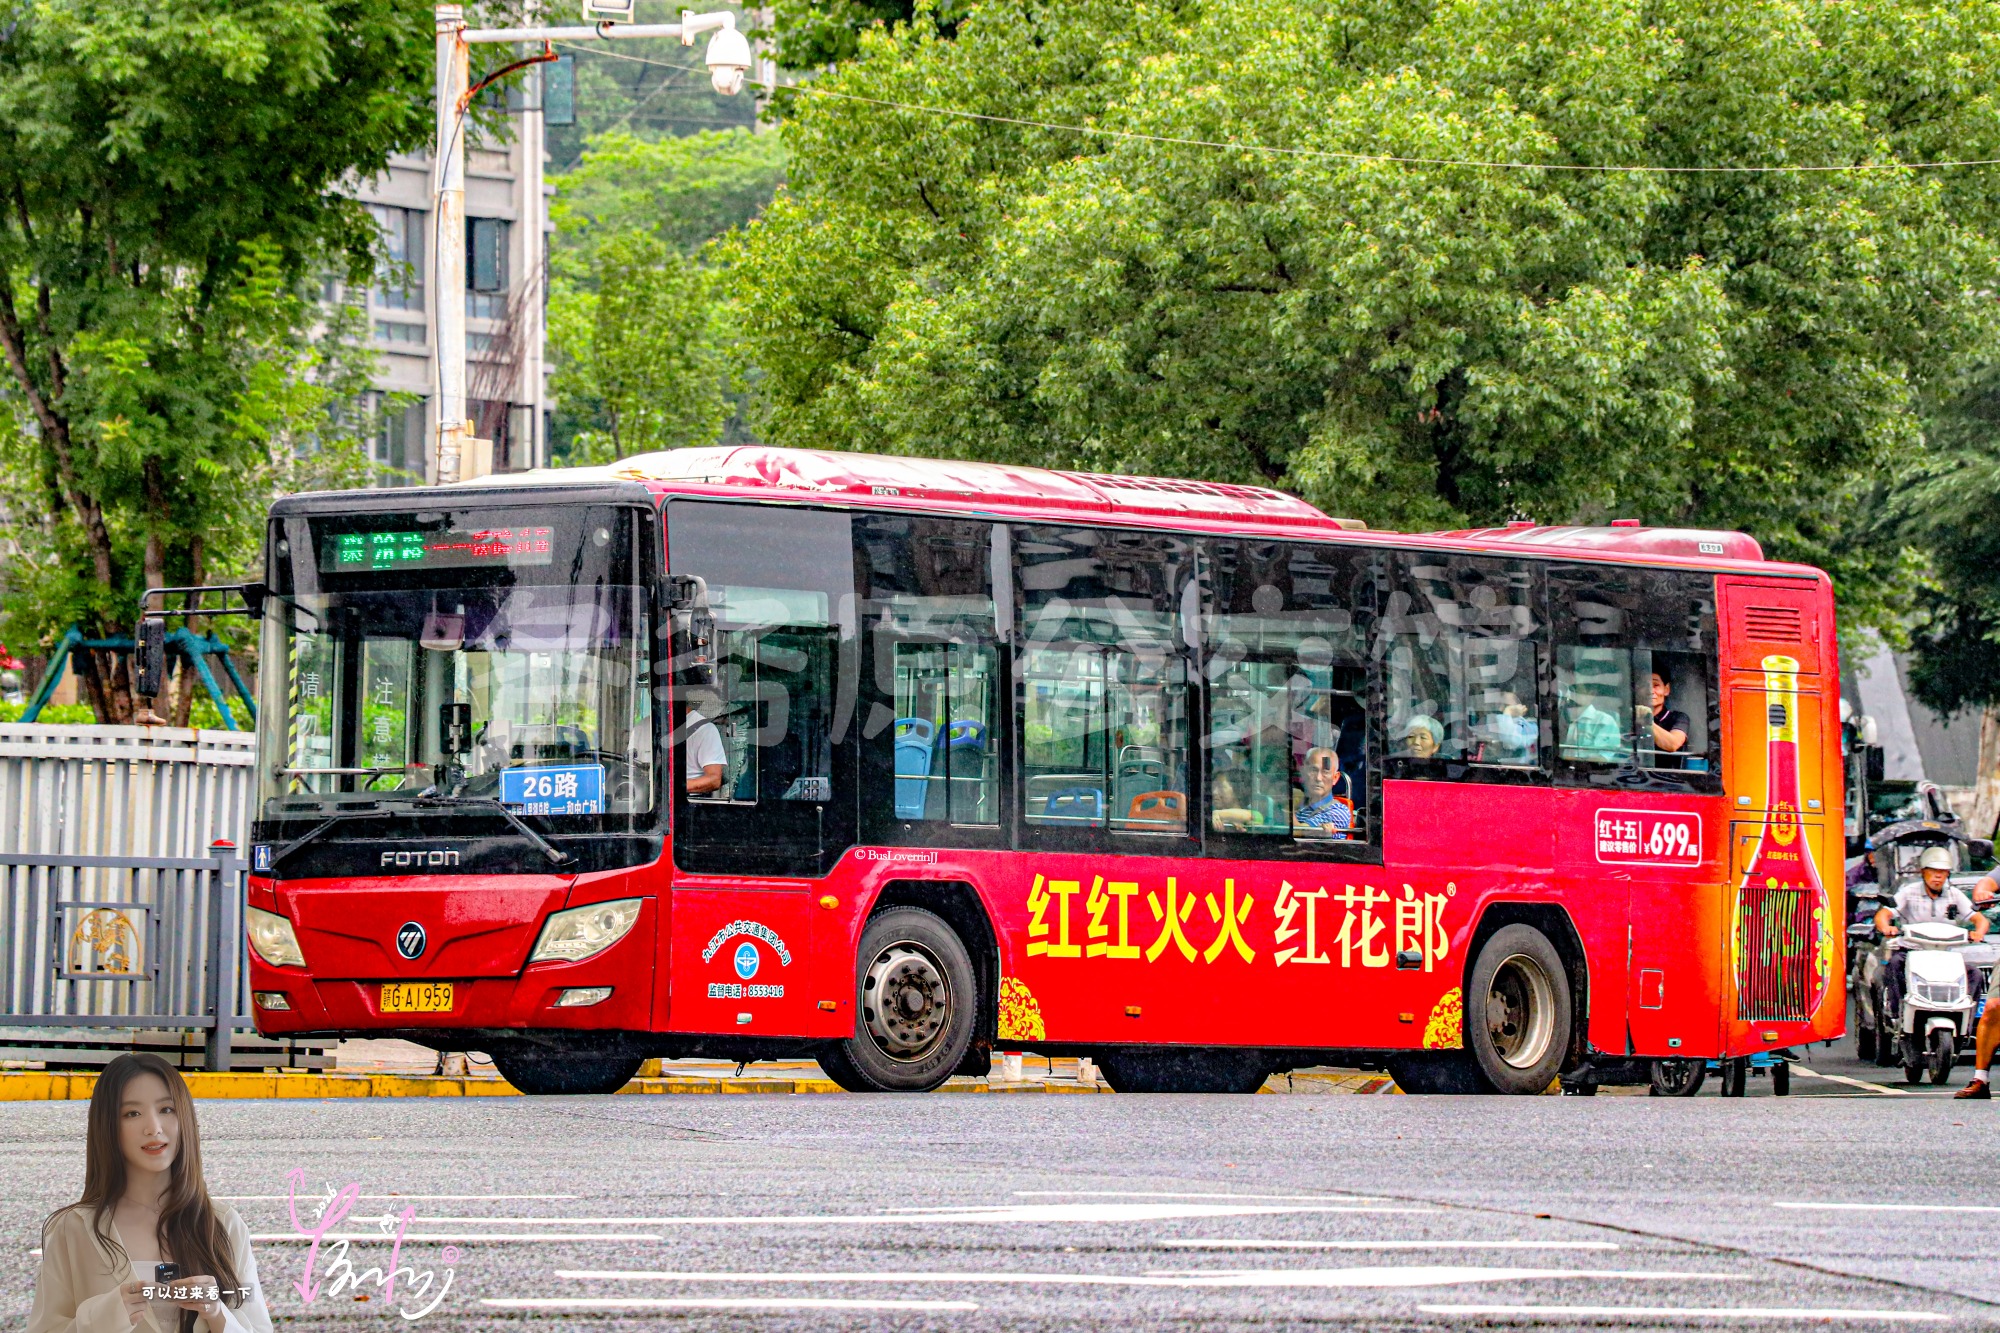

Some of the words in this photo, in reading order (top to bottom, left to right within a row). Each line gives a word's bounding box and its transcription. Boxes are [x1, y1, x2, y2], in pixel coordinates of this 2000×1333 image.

[523, 772, 578, 798] 26路
[1599, 819, 1638, 840] 红十五
[380, 850, 460, 867] FOTON
[1599, 840, 1637, 854] 建议零售价
[1026, 873, 1256, 964] 红红火火
[702, 920, 791, 966] 九江市公共交通集团公司
